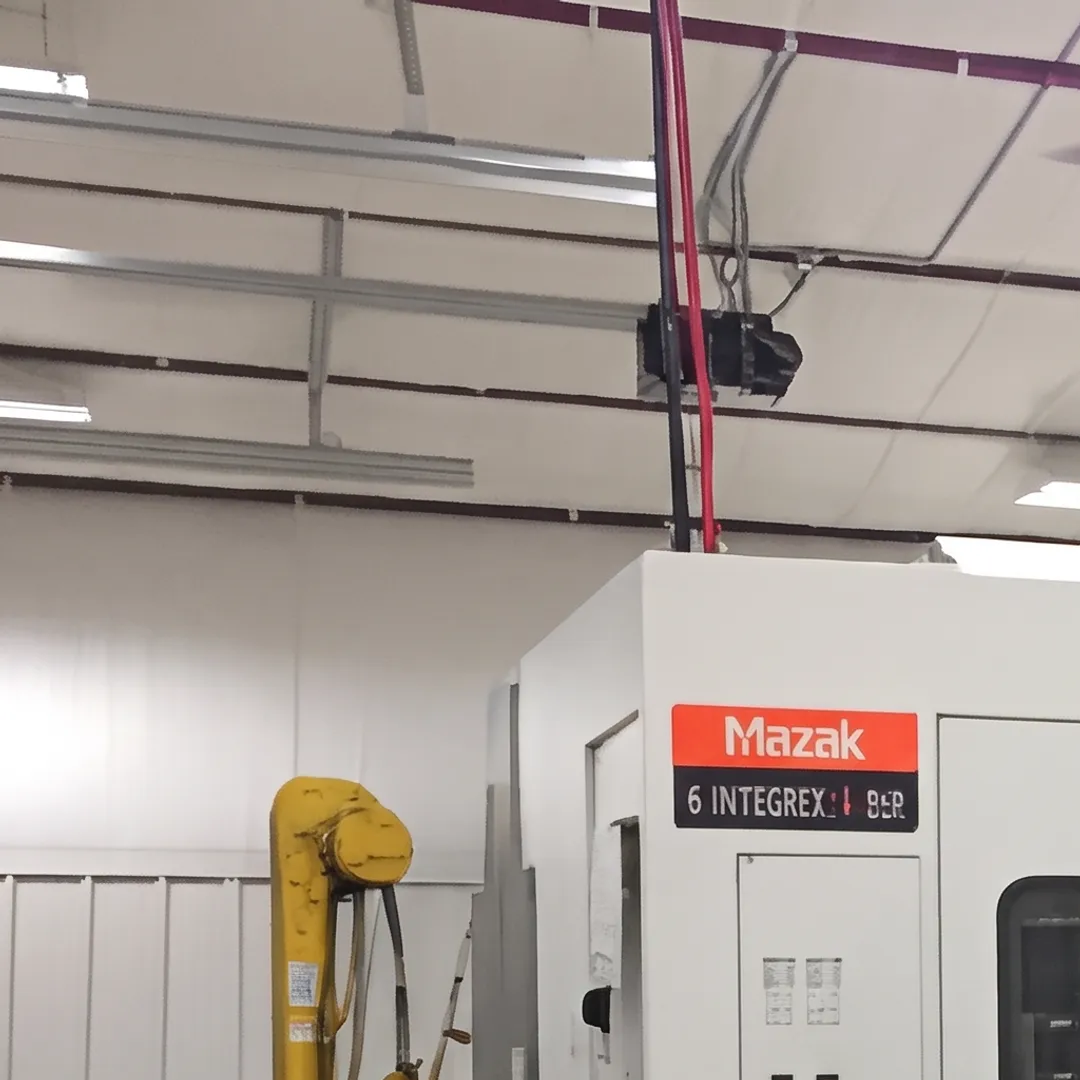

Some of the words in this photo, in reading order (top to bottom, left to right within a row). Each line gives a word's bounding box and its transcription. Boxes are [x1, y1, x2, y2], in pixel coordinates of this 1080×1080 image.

[724, 716, 866, 761] Mazak
[687, 785, 702, 815] 6
[711, 785, 826, 818] INTEGREX
